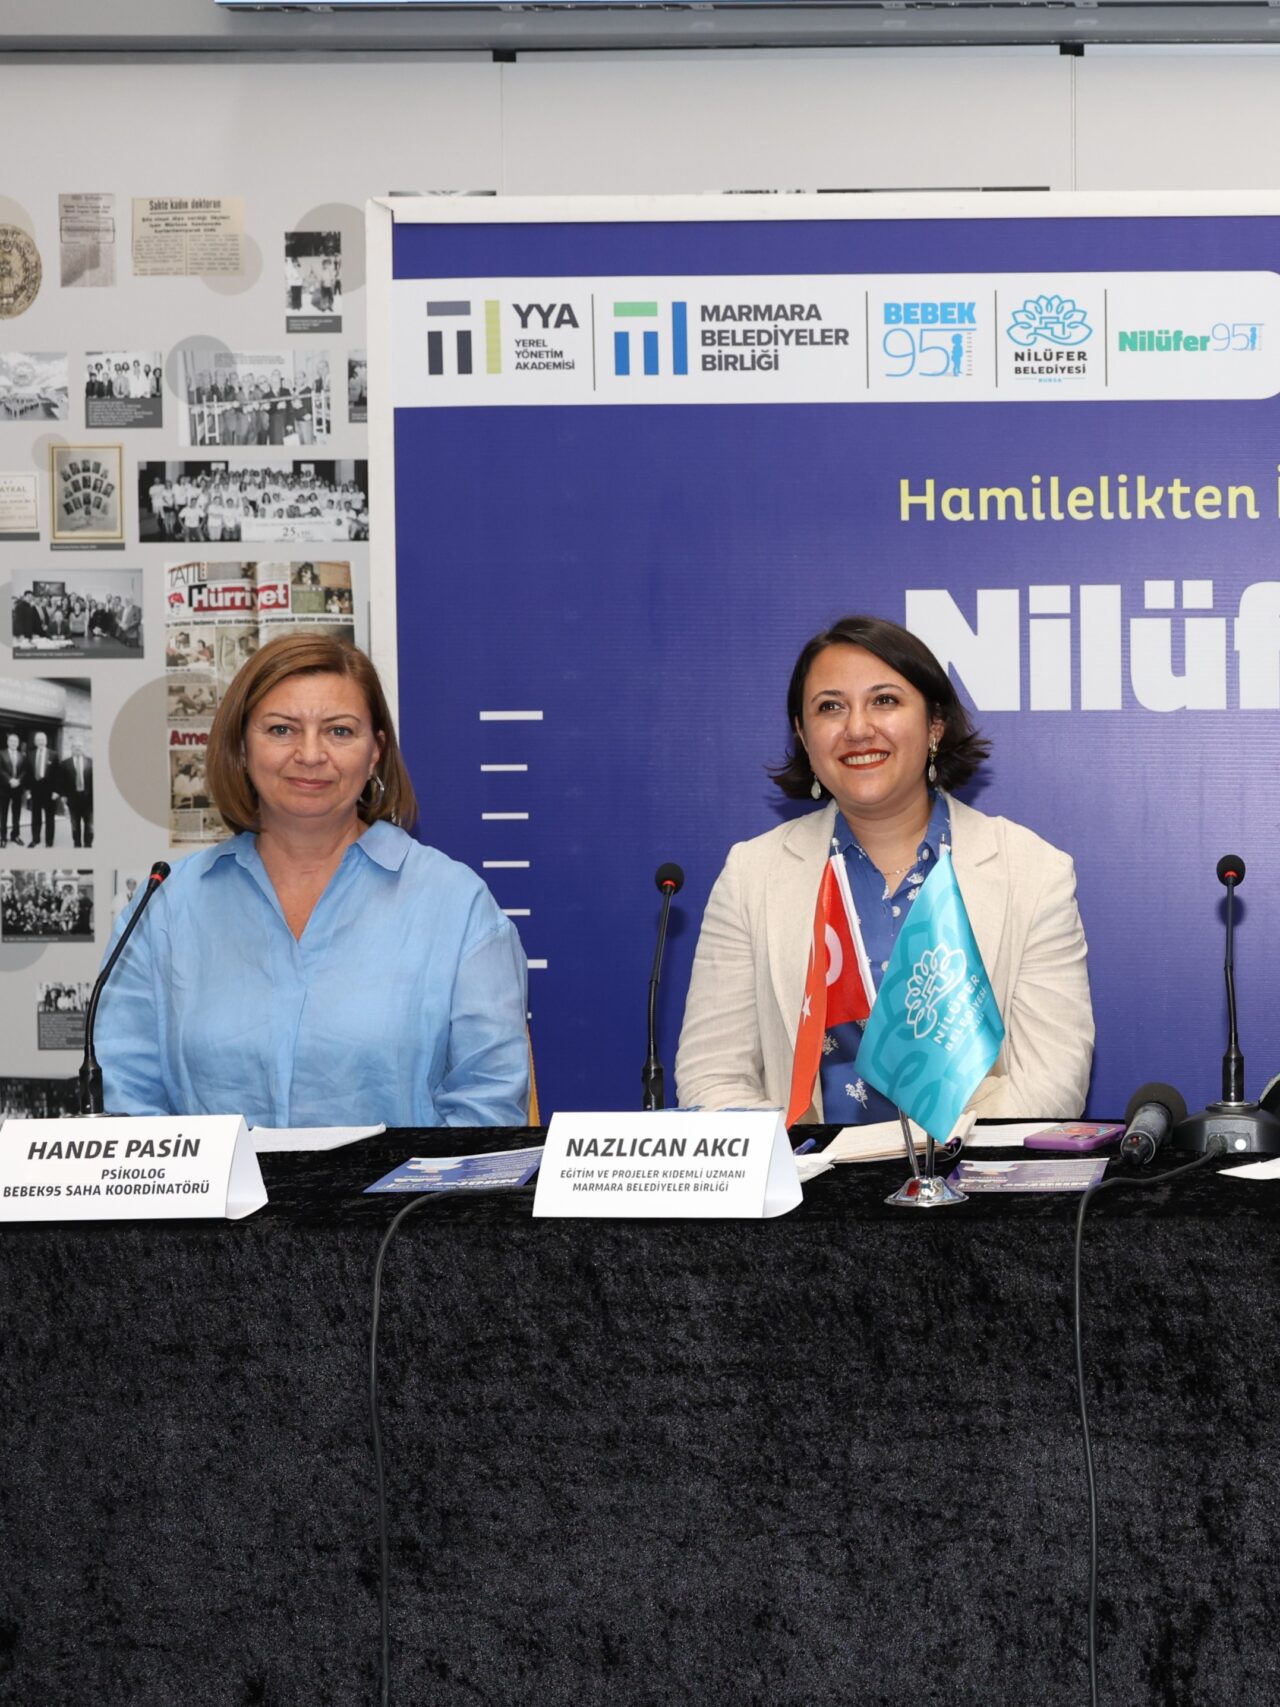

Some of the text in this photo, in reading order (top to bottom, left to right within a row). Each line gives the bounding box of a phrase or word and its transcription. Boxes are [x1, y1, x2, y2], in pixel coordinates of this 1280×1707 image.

[512, 303, 579, 329] YYA
[701, 304, 822, 323] MARMARA
[884, 302, 976, 325] BEBEK
[515, 338, 548, 348] YEREL
[701, 325, 849, 347] BELEDİYELER
[1118, 330, 1210, 352] Nilüfer
[514, 348, 563, 360] YÖNETİM
[702, 350, 779, 371] BİRLİĞİ
[883, 327, 976, 378] 95
[1014, 348, 1088, 363] NİLÜFER
[514, 360, 575, 371] AKADEMİSİ
[1014, 364, 1087, 375] BELEDİYESİ
[898, 473, 1260, 522] Hamilelikten
[27, 1133, 201, 1160] HANDE PASİN
[565, 1137, 750, 1158] NAZLICAN AKCI
[100, 1165, 166, 1180] PSİKOLOG
[559, 1167, 746, 1180] EĞİTİM VE PROJELER KIDEMLİ UZMANI
[2, 1180, 210, 1198] BEBEK95 SAHA KOORDİNATÖRÜ
[572, 1179, 729, 1192] MARMARA BELEDİYELER BİRLİĞİ
